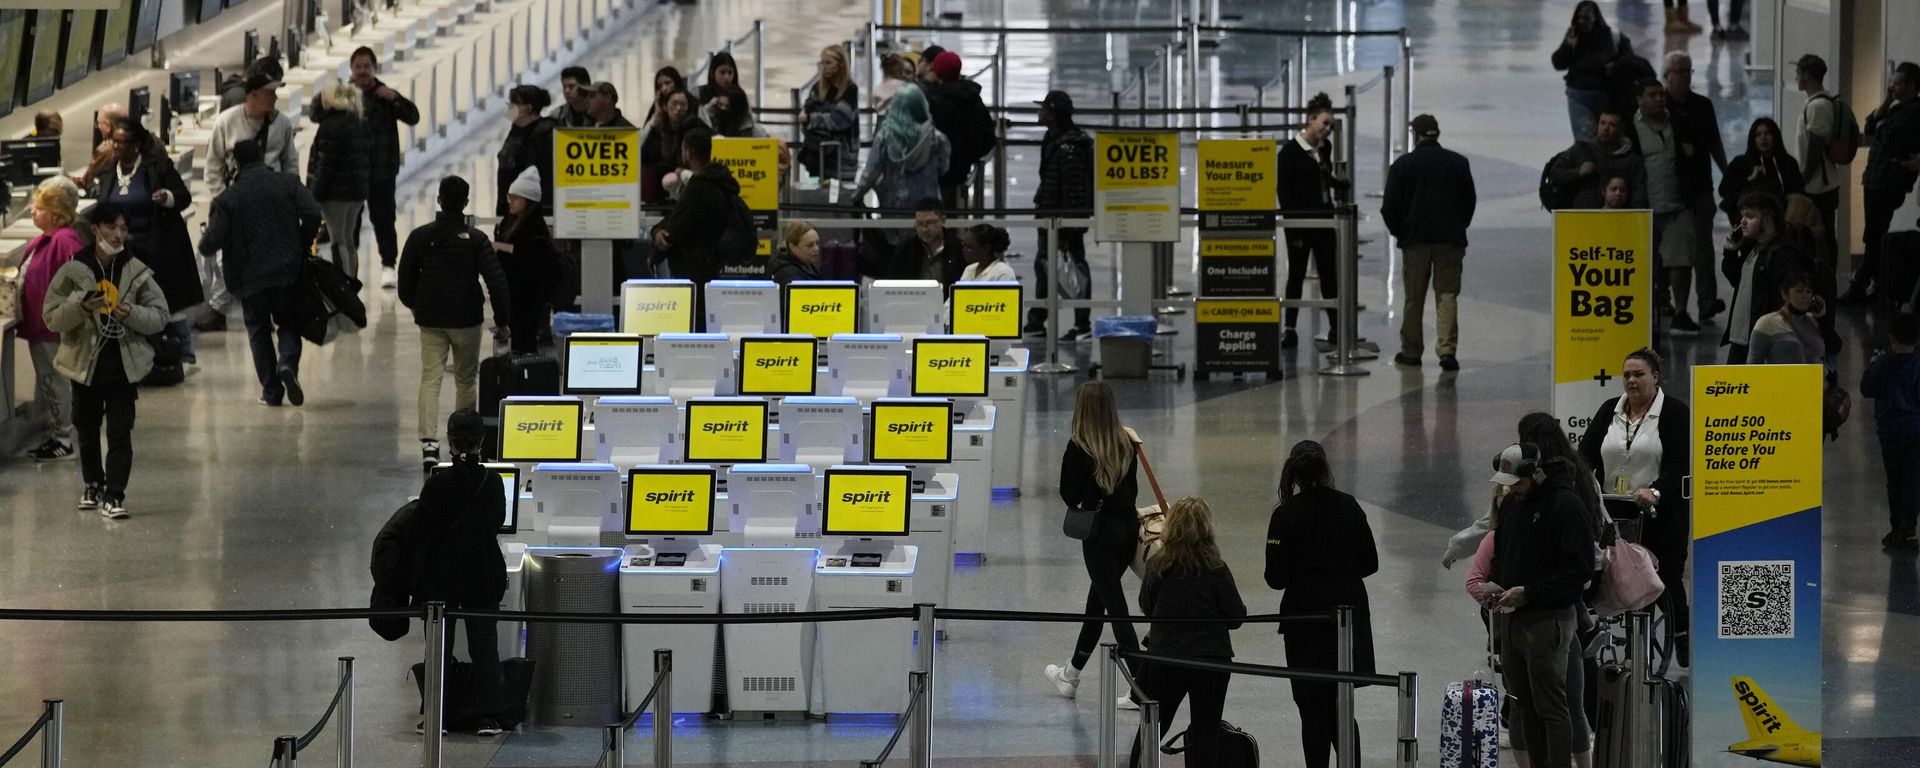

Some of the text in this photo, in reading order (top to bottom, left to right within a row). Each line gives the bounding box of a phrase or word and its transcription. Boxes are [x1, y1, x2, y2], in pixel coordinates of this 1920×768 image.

[566, 142, 628, 159] OVER
[1106, 145, 1168, 163] OVER
[566, 163, 628, 176] 40 LBS?
[1205, 160, 1254, 169] Measure
[738, 168, 766, 181] Bags
[1106, 167, 1168, 179] 40 LBS?
[1205, 171, 1264, 183] Your Bags
[1569, 247, 1634, 264] Self-Tag
[724, 264, 765, 274] Included
[1207, 266, 1268, 275] One Included
[1568, 263, 1635, 287] Your
[636, 300, 678, 313] spirit
[801, 302, 842, 314] spirit
[965, 302, 1007, 314] spirit
[1211, 308, 1272, 316] CARRY-ON BAG
[1571, 290, 1634, 325] Bag
[1219, 330, 1256, 341] Charge
[1219, 341, 1257, 352] Applies
[756, 356, 799, 368] spirit
[928, 356, 972, 369] spirit
[1705, 383, 1750, 397] spirit
[516, 420, 564, 433] spirit
[702, 420, 749, 434] spirit
[887, 421, 934, 434] spirit
[1705, 416, 1765, 428] Land 500
[1705, 429, 1792, 441] Bonus Points
[1705, 444, 1776, 455] Before You
[1705, 457, 1760, 470] Take Off
[645, 490, 695, 504] spirit
[841, 491, 891, 505] spirit
[1735, 680, 1782, 734] spirit
